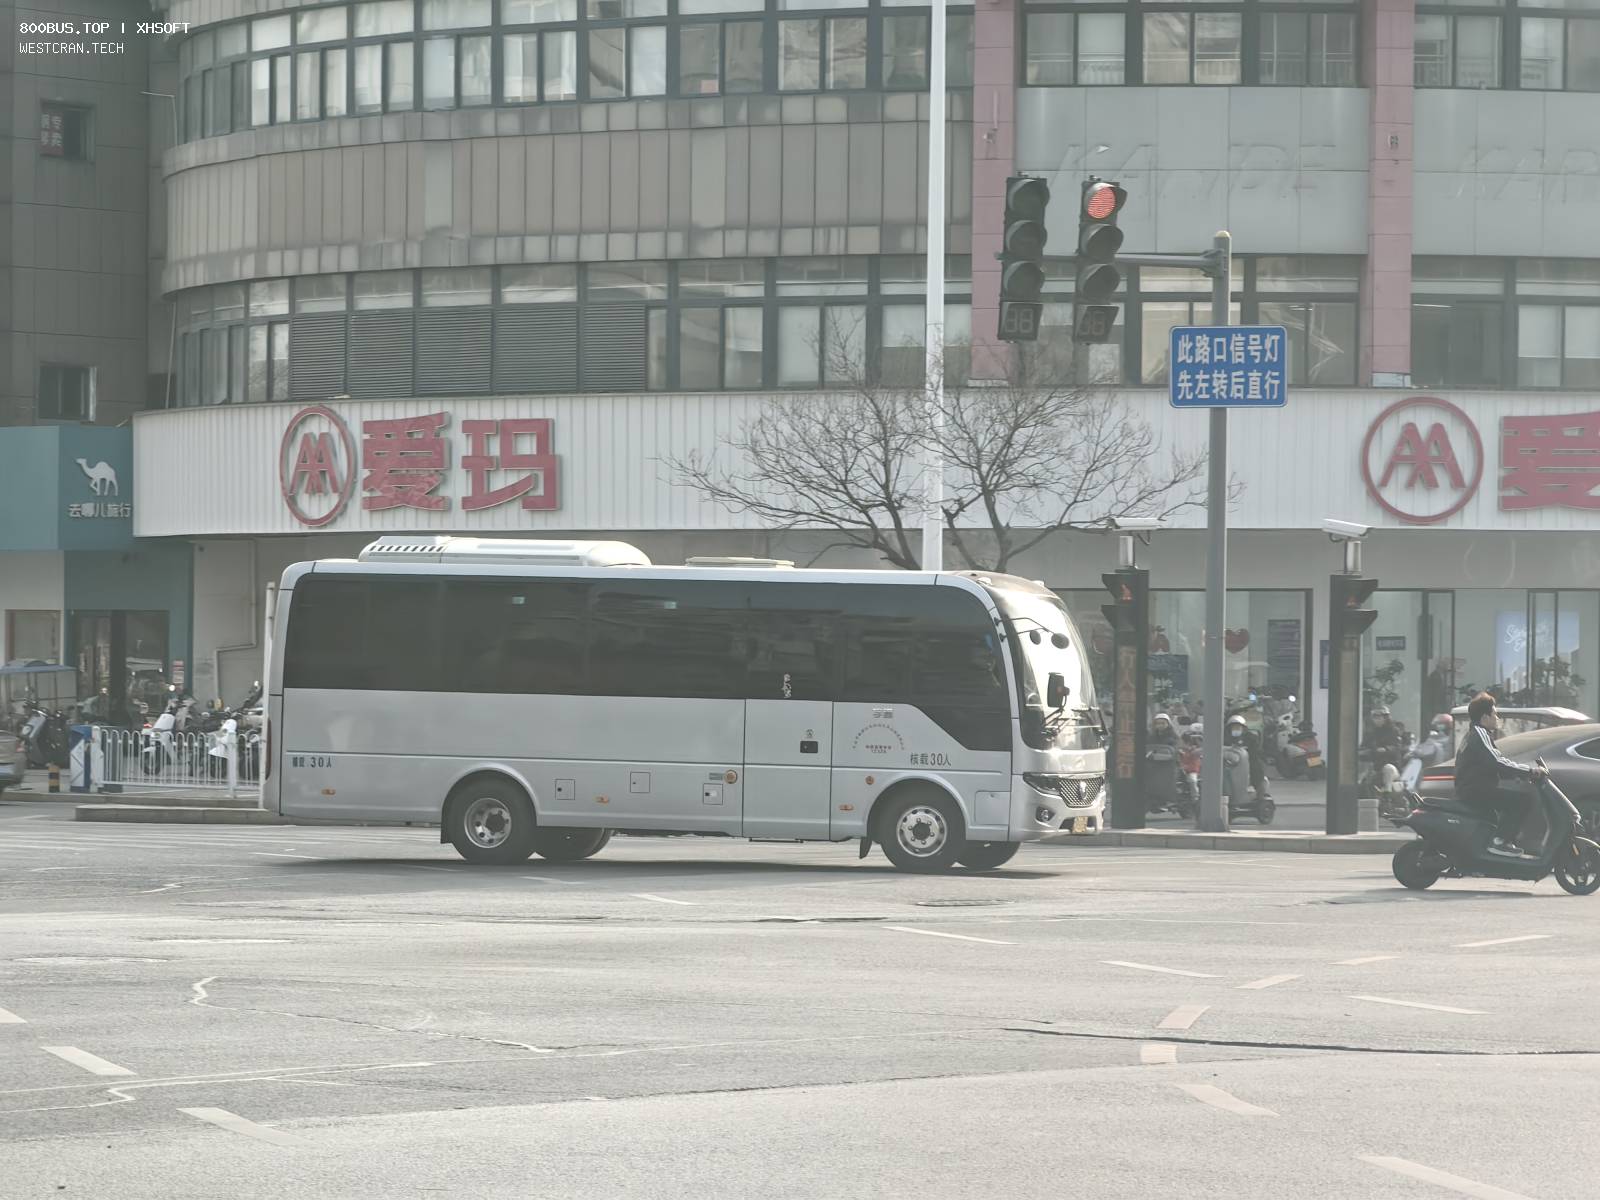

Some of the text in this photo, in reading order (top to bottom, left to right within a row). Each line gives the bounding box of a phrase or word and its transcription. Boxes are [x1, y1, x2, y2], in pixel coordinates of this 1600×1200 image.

[1177, 333, 1280, 364] 此路口信号灯
[1178, 369, 1280, 400] 先左转后直行
[362, 411, 560, 511] 爱玛
[910, 752, 952, 766] 核载30人
